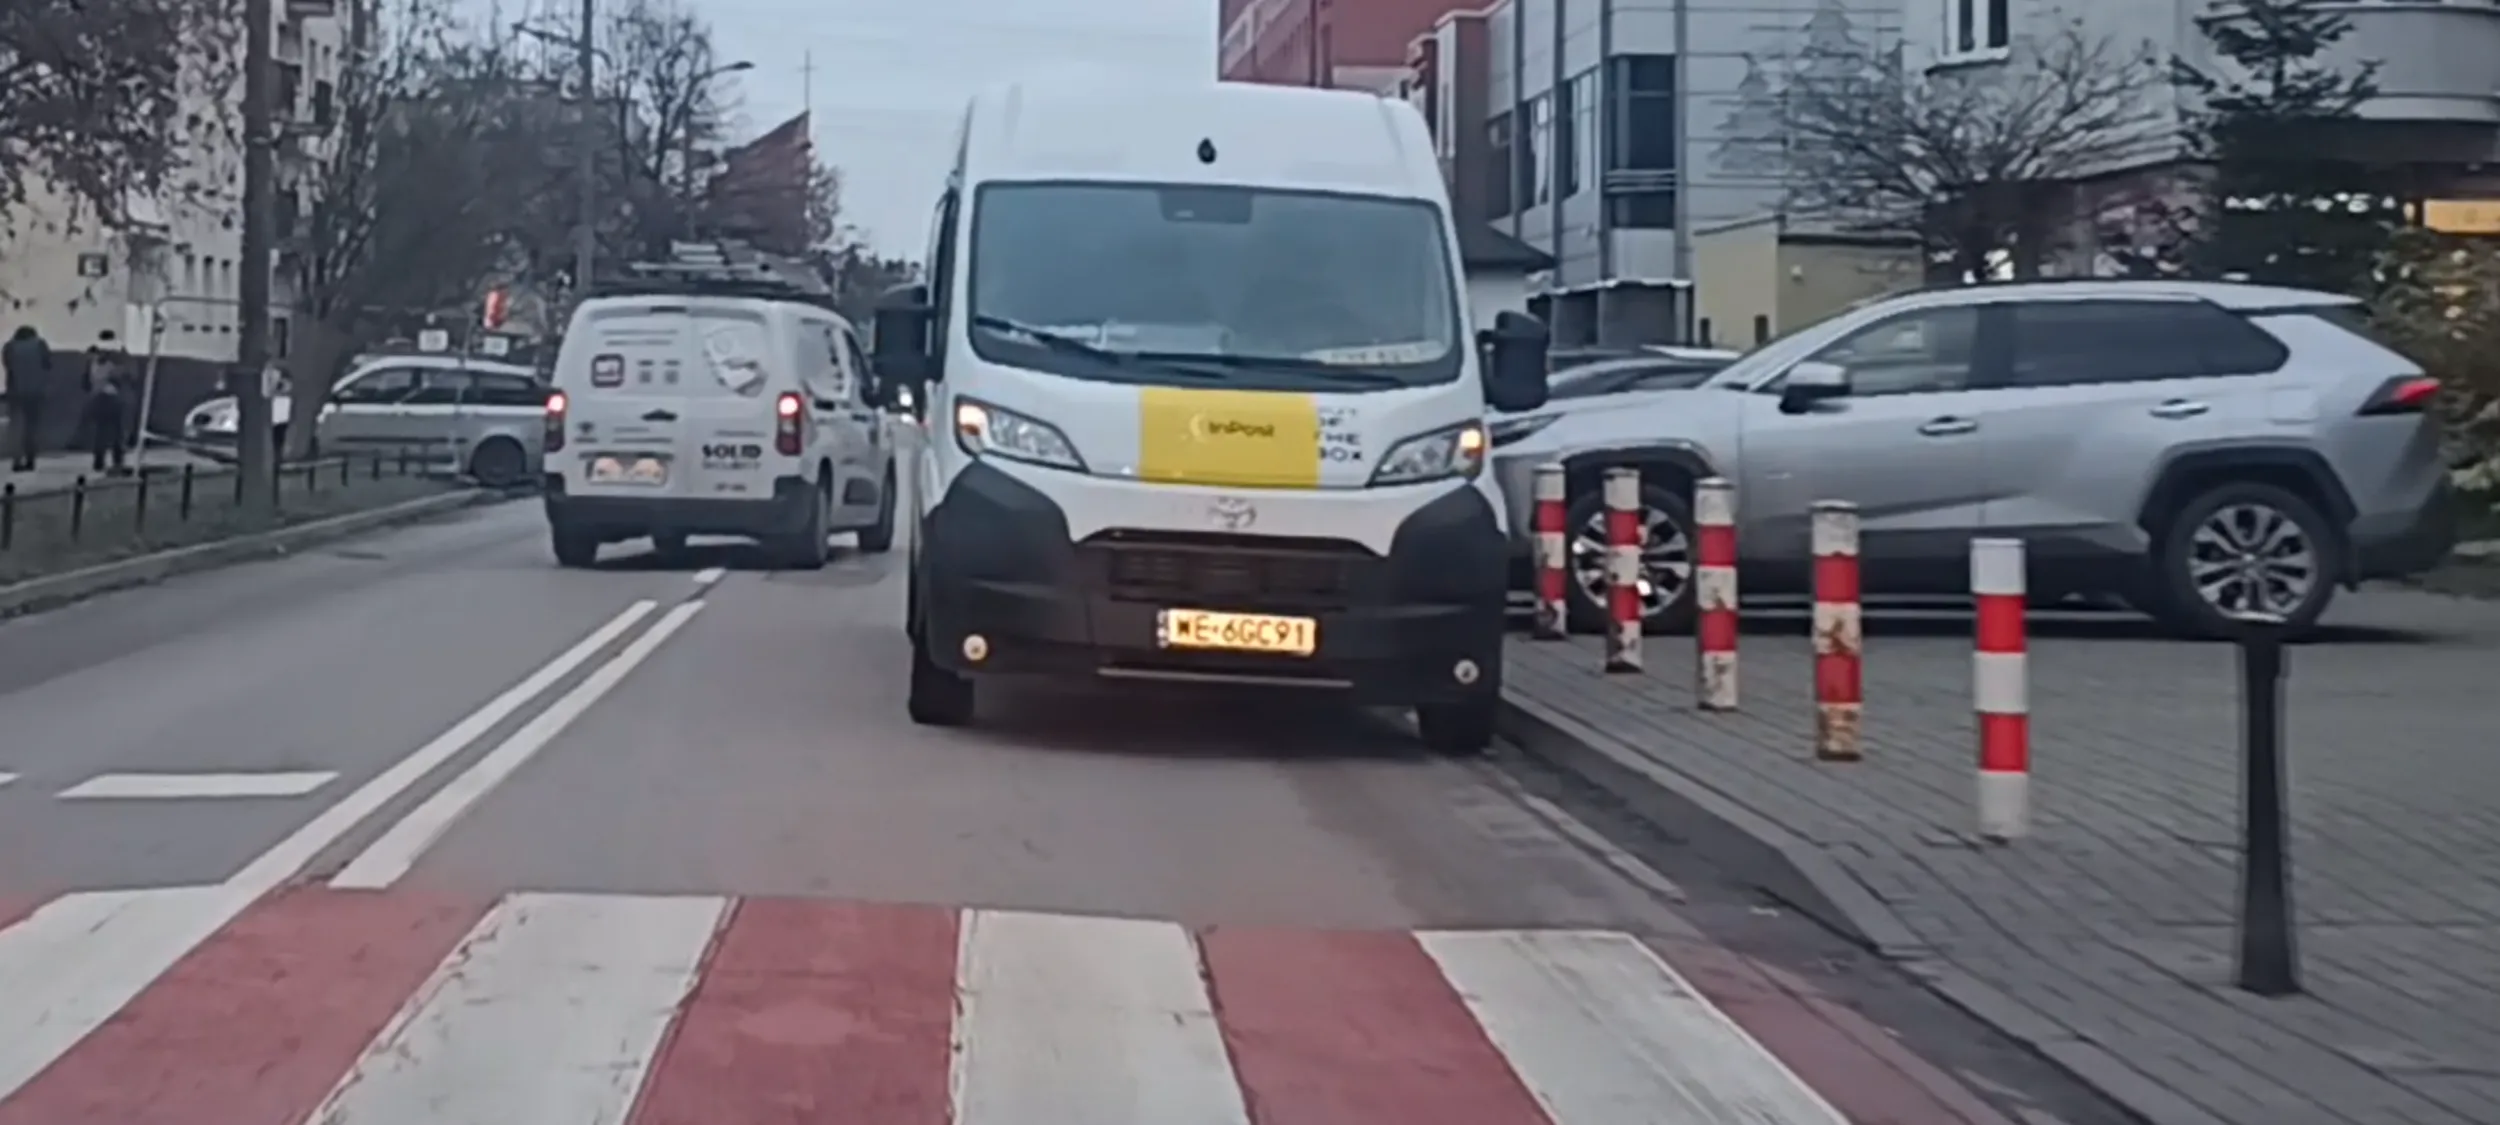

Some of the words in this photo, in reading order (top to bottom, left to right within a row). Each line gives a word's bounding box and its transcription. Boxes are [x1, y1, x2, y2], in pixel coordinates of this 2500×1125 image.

[1209, 421, 1275, 437] InPost
[702, 444, 762, 458] SOLID
[1222, 618, 1302, 647] 6GC91
